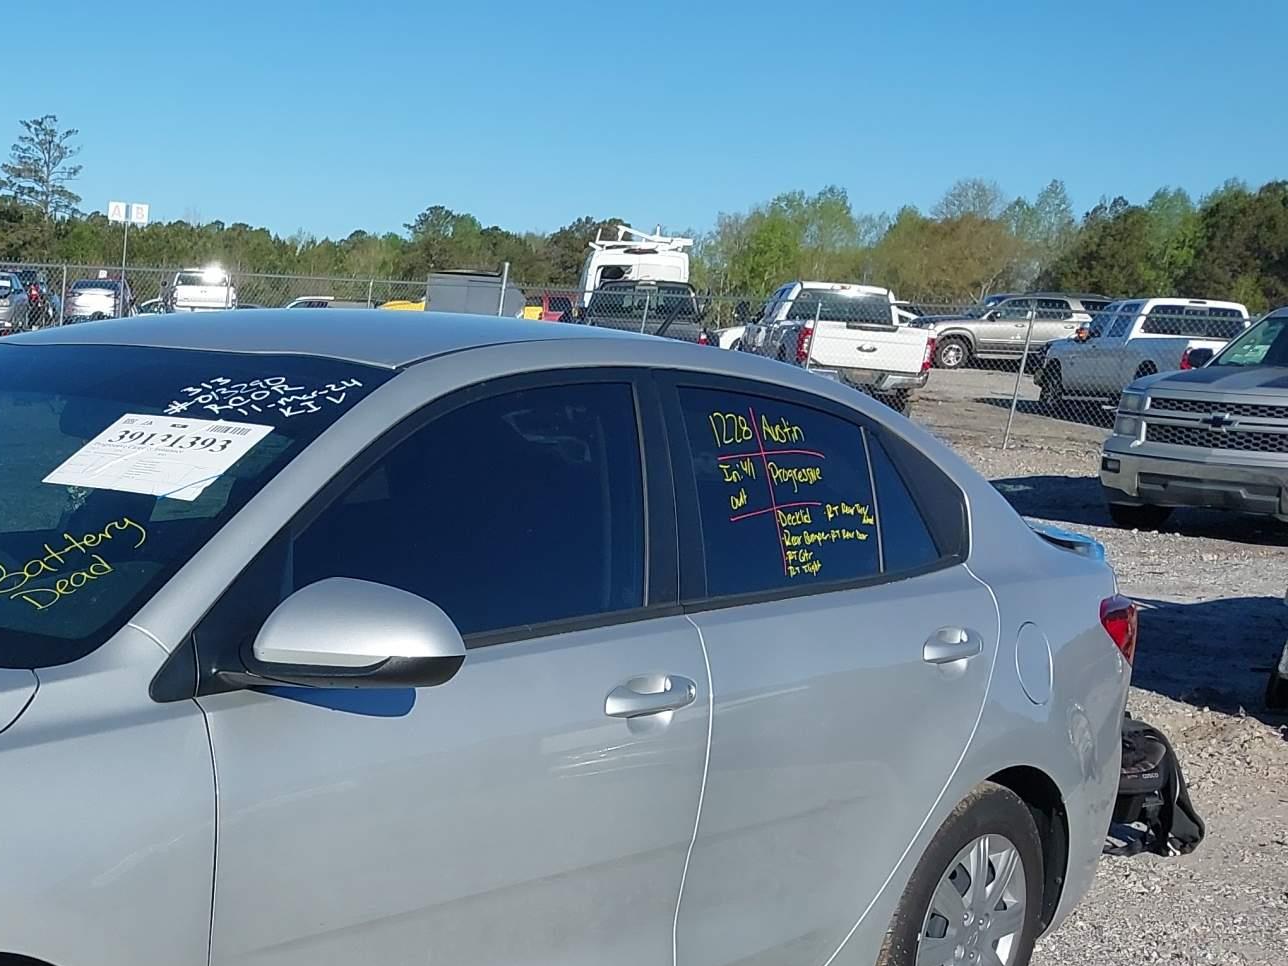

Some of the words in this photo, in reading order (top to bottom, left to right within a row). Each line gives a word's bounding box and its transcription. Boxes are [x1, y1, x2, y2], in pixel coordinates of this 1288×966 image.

[106, 428, 233, 453] 39131393
[709, 411, 753, 449] 1228
[760, 413, 805, 445] Austin
[768, 461, 823, 493] Progressive
[10, 554, 114, 610] Dead
